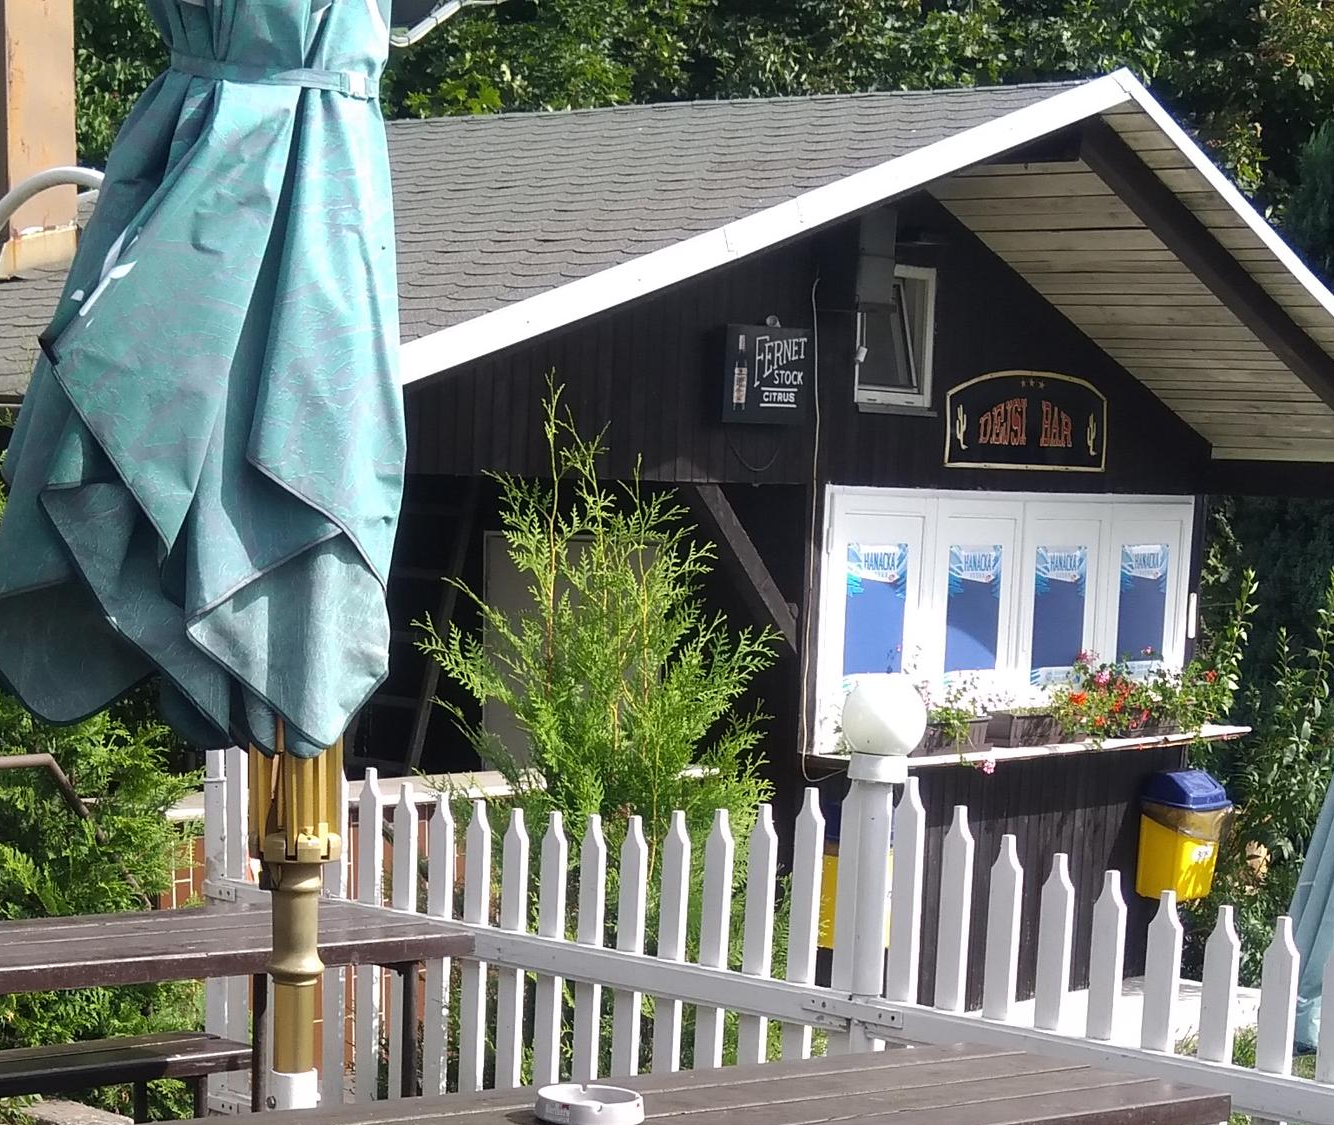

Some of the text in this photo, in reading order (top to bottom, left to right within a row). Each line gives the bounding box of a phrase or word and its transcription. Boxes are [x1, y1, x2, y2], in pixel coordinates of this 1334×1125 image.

[754, 335, 808, 388] FERNET
[773, 370, 804, 385] STOCK
[762, 391, 796, 403] CITRUS
[978, 398, 1073, 447] DEJSI BAR
